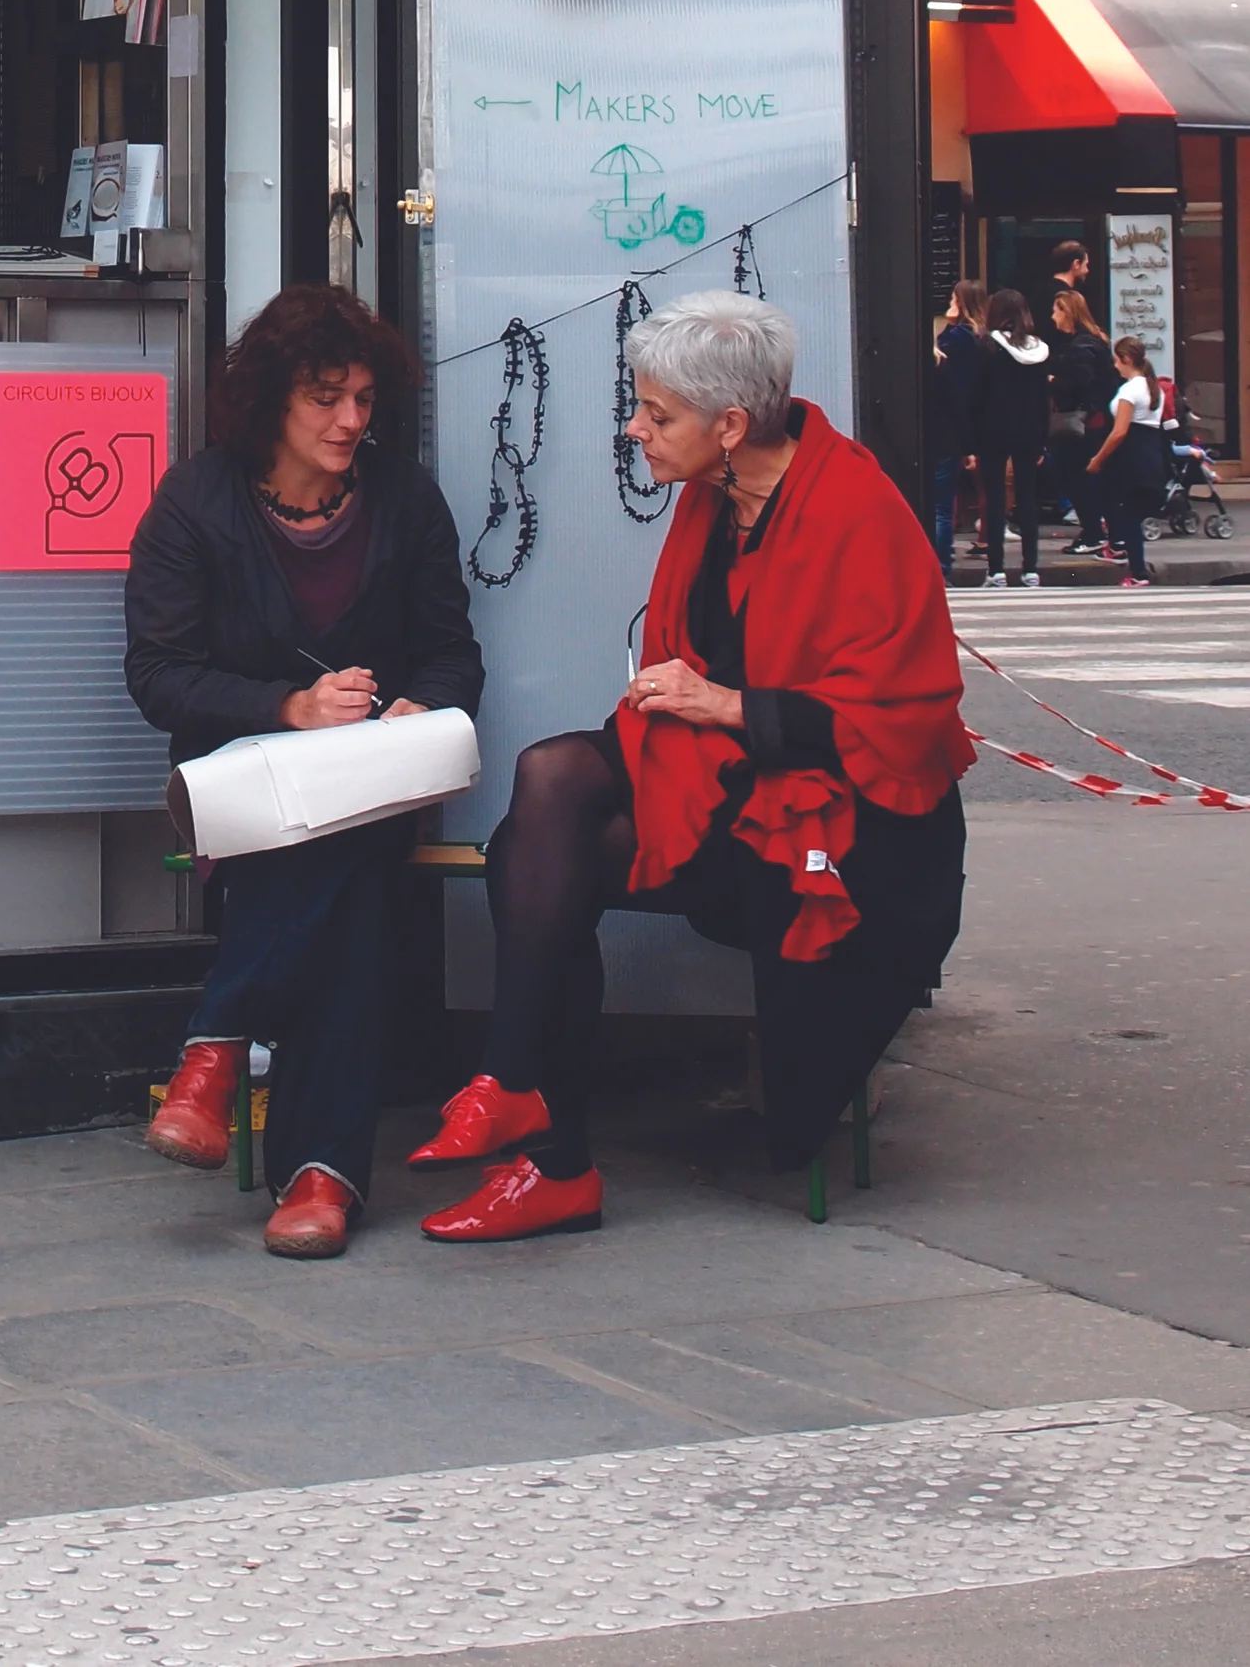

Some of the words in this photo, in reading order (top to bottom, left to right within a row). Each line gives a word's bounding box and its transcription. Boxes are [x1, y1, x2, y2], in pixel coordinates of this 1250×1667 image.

[555, 80, 675, 124] MAKERS
[697, 92, 779, 119] MOVE
[3, 385, 85, 401] CIRCUITS
[91, 386, 155, 402] BIJOUX
